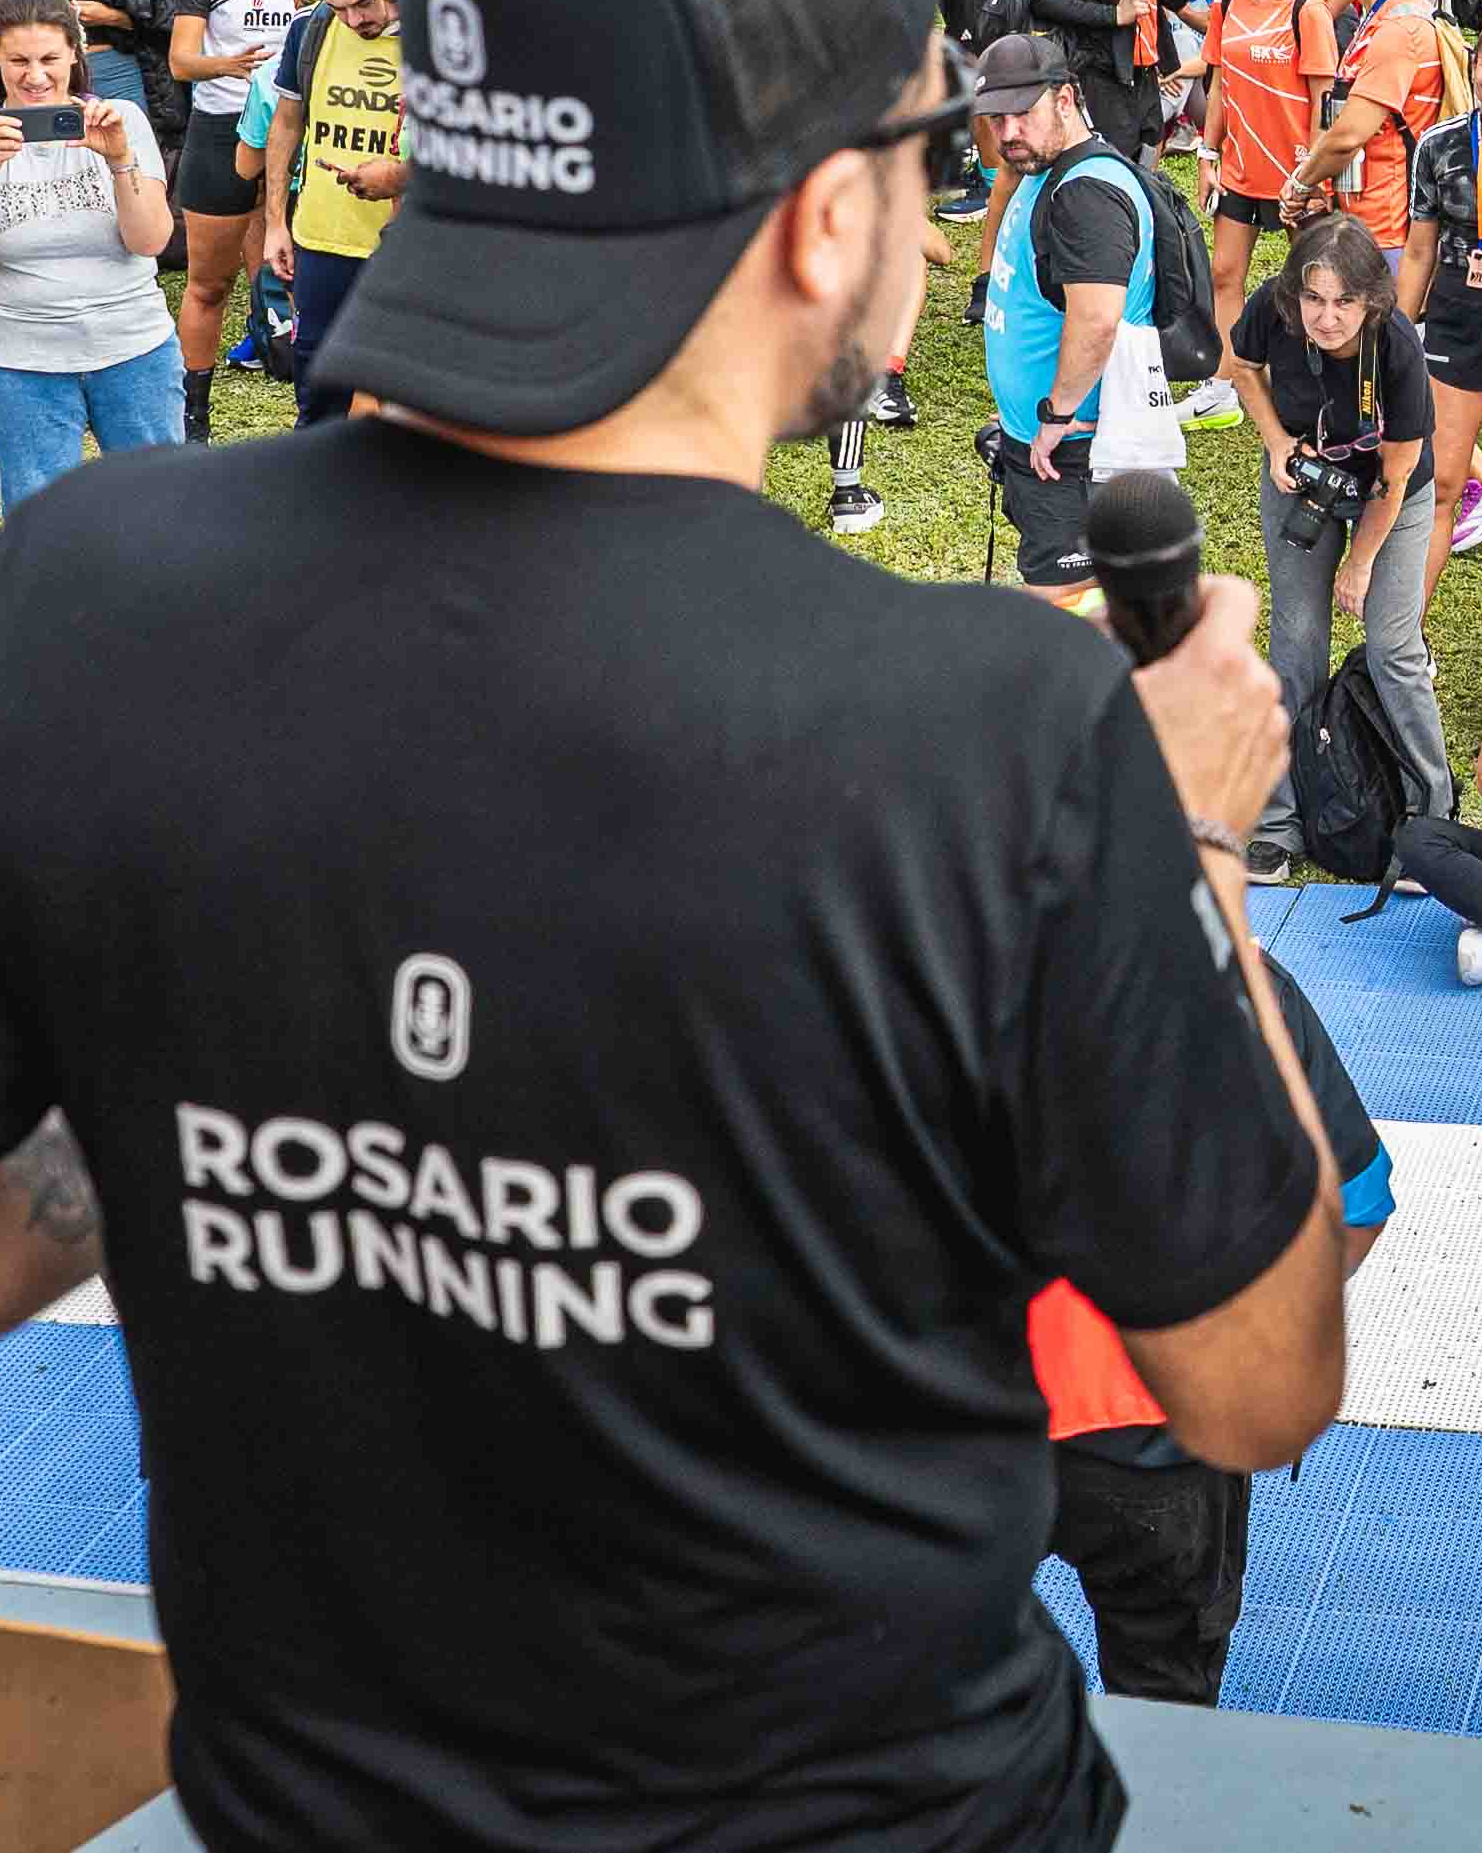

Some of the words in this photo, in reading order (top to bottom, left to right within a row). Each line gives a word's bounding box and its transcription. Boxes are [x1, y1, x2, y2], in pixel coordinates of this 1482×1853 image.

[1361, 379, 1373, 416] Nikon
[174, 1101, 705, 1259] ROSARIO
[181, 1196, 715, 1351] RUNNING
